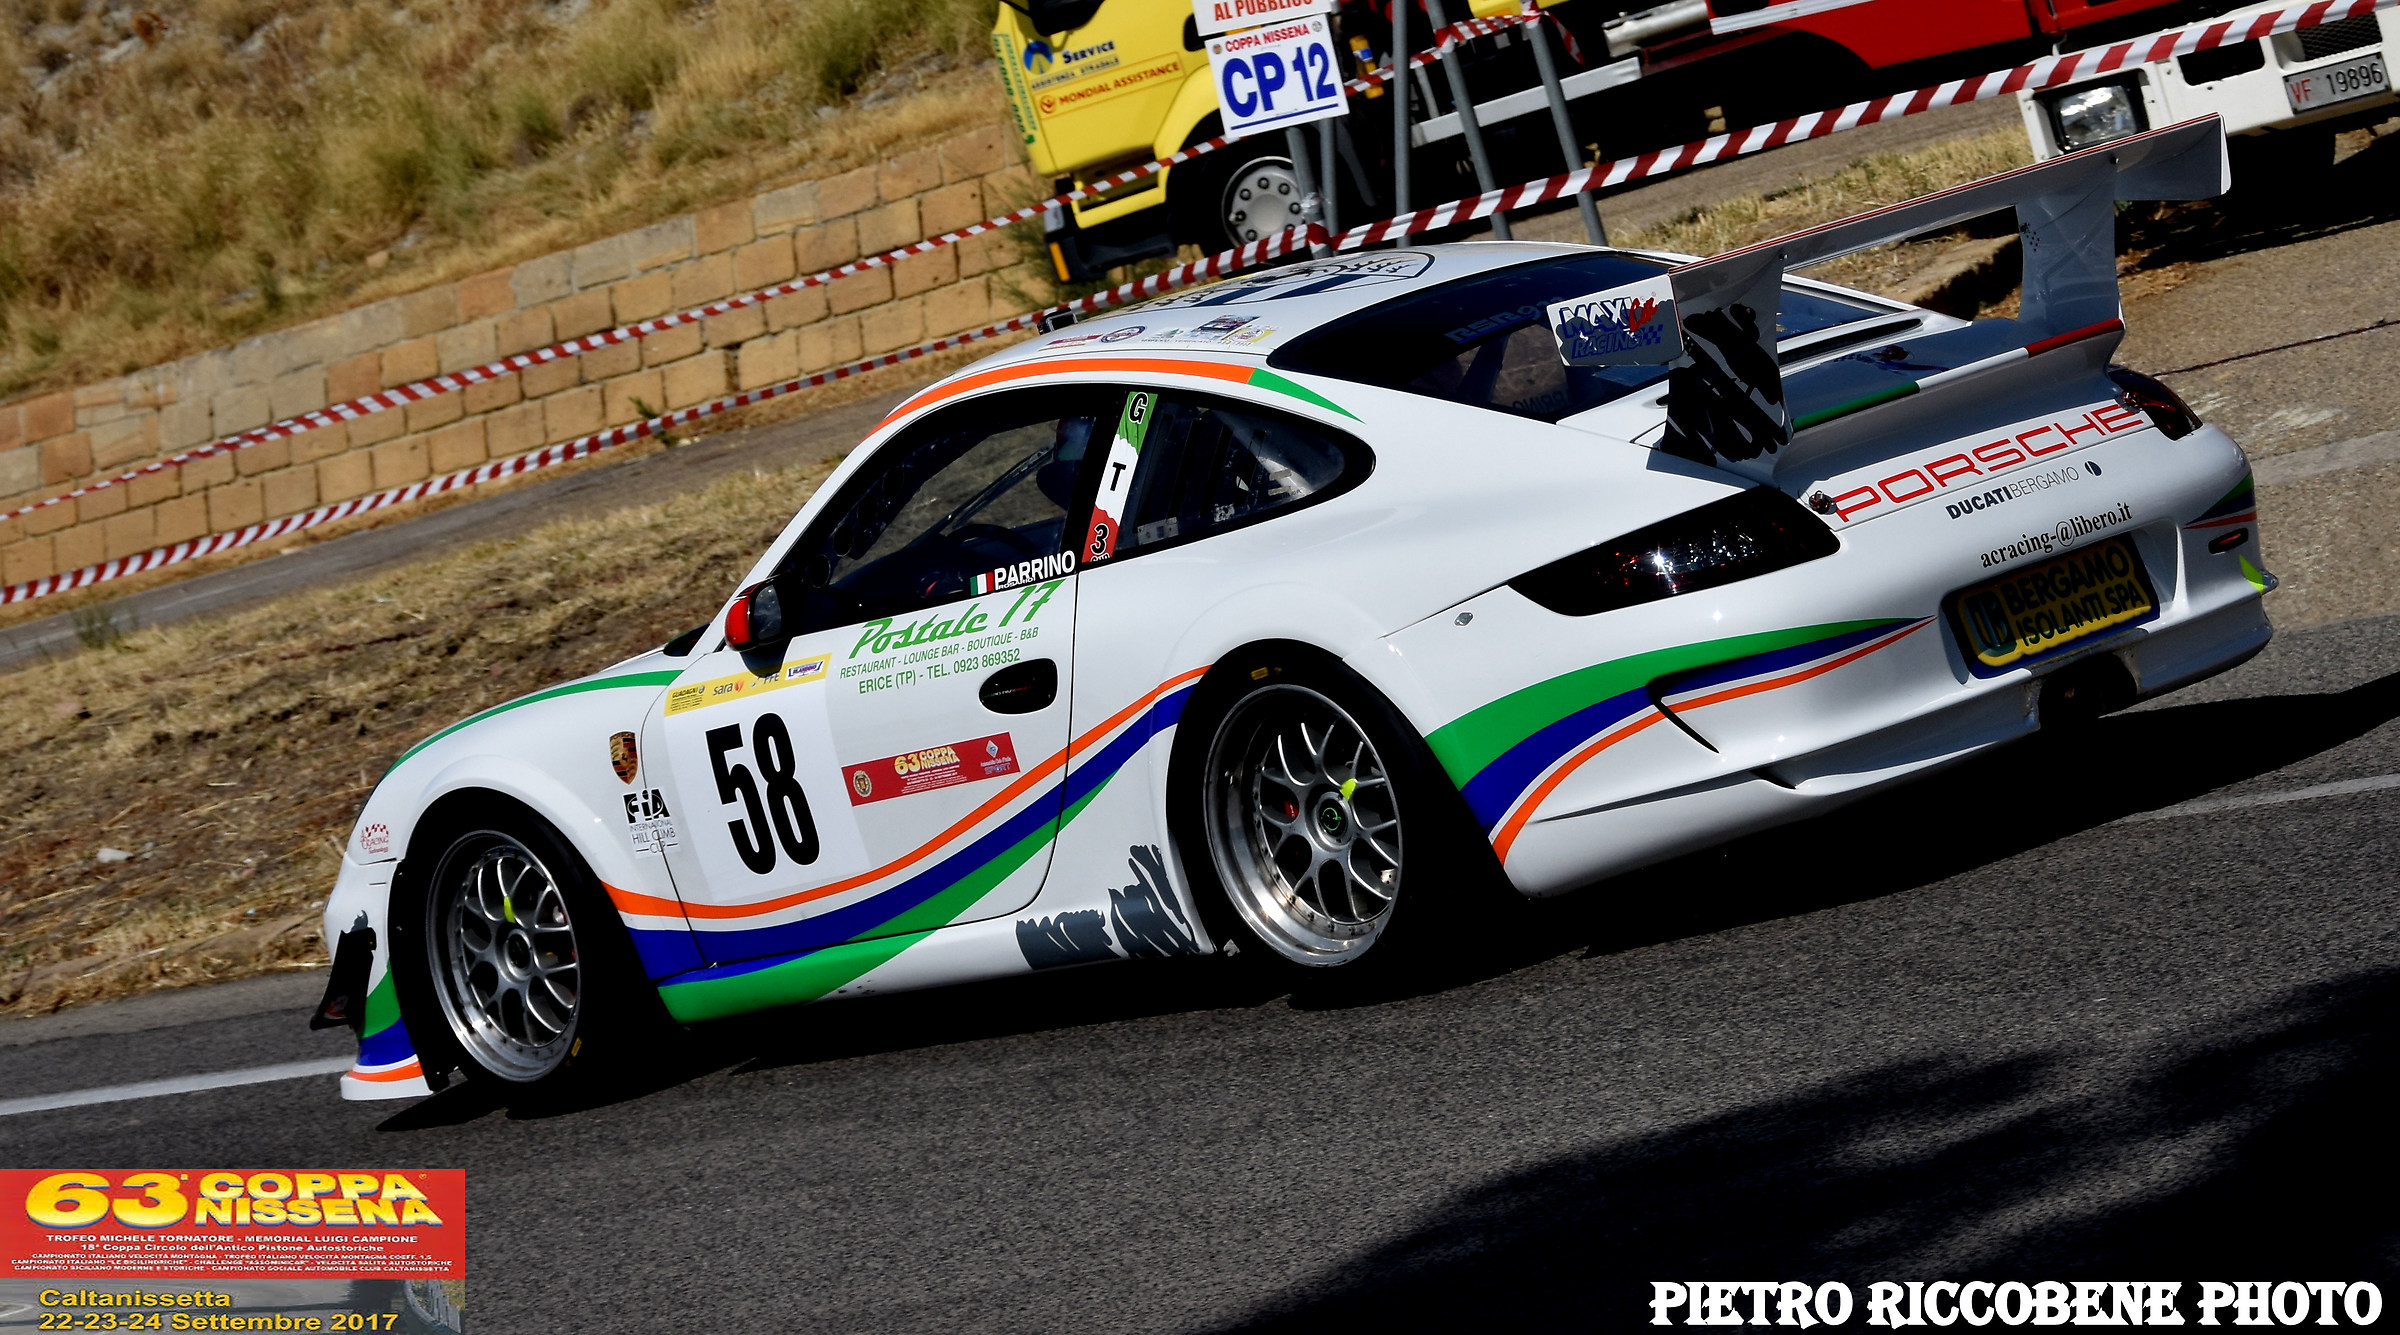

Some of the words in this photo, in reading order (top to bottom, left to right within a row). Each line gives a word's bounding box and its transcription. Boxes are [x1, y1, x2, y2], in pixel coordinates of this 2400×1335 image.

[1214, 2, 1232, 21] AL
[1225, 34, 1262, 52] COPPA
[1262, 23, 1310, 44] NISSENA
[1059, 83, 1111, 104] MONDIAL
[1113, 61, 1179, 88] ASSISTANCE
[1222, 52, 1286, 118] CP
[1292, 42, 1337, 102] 12
[2290, 78, 2311, 103] VF
[2326, 62, 2383, 95] 19896
[1128, 392, 1148, 425] G
[1110, 462, 1126, 492] T
[1833, 402, 2144, 523] PORSCHE
[1090, 524, 1109, 555] 3
[1980, 502, 2133, 568] acracing-@libero.it
[994, 550, 1076, 590] PARRINO
[2001, 545, 2130, 616] BERGAMO
[849, 602, 989, 660] Postale
[998, 578, 1067, 627] 17
[2016, 591, 2107, 647] ISOLANTI
[2106, 579, 2146, 615] SPA
[840, 655, 896, 679] RESTAURANT
[903, 645, 939, 665] LOUNGE
[941, 643, 960, 657] BAR
[967, 632, 1013, 651] BOUTIQUE
[1020, 627, 1039, 641] B&B
[859, 675, 893, 694] ERICE
[895, 669, 917, 690] (TP)
[927, 663, 951, 680] TEL.
[953, 656, 979, 675] 0923
[981, 648, 1021, 669] 869352
[713, 682, 734, 696] sara
[919, 746, 956, 760] COPPA
[921, 754, 960, 770] NISSENA
[705, 712, 820, 875] 58
[629, 820, 673, 832] INTERNATIONAL
[632, 833, 651, 845] HILL
[651, 828, 676, 843] CLIMB
[650, 843, 666, 854] CUP
